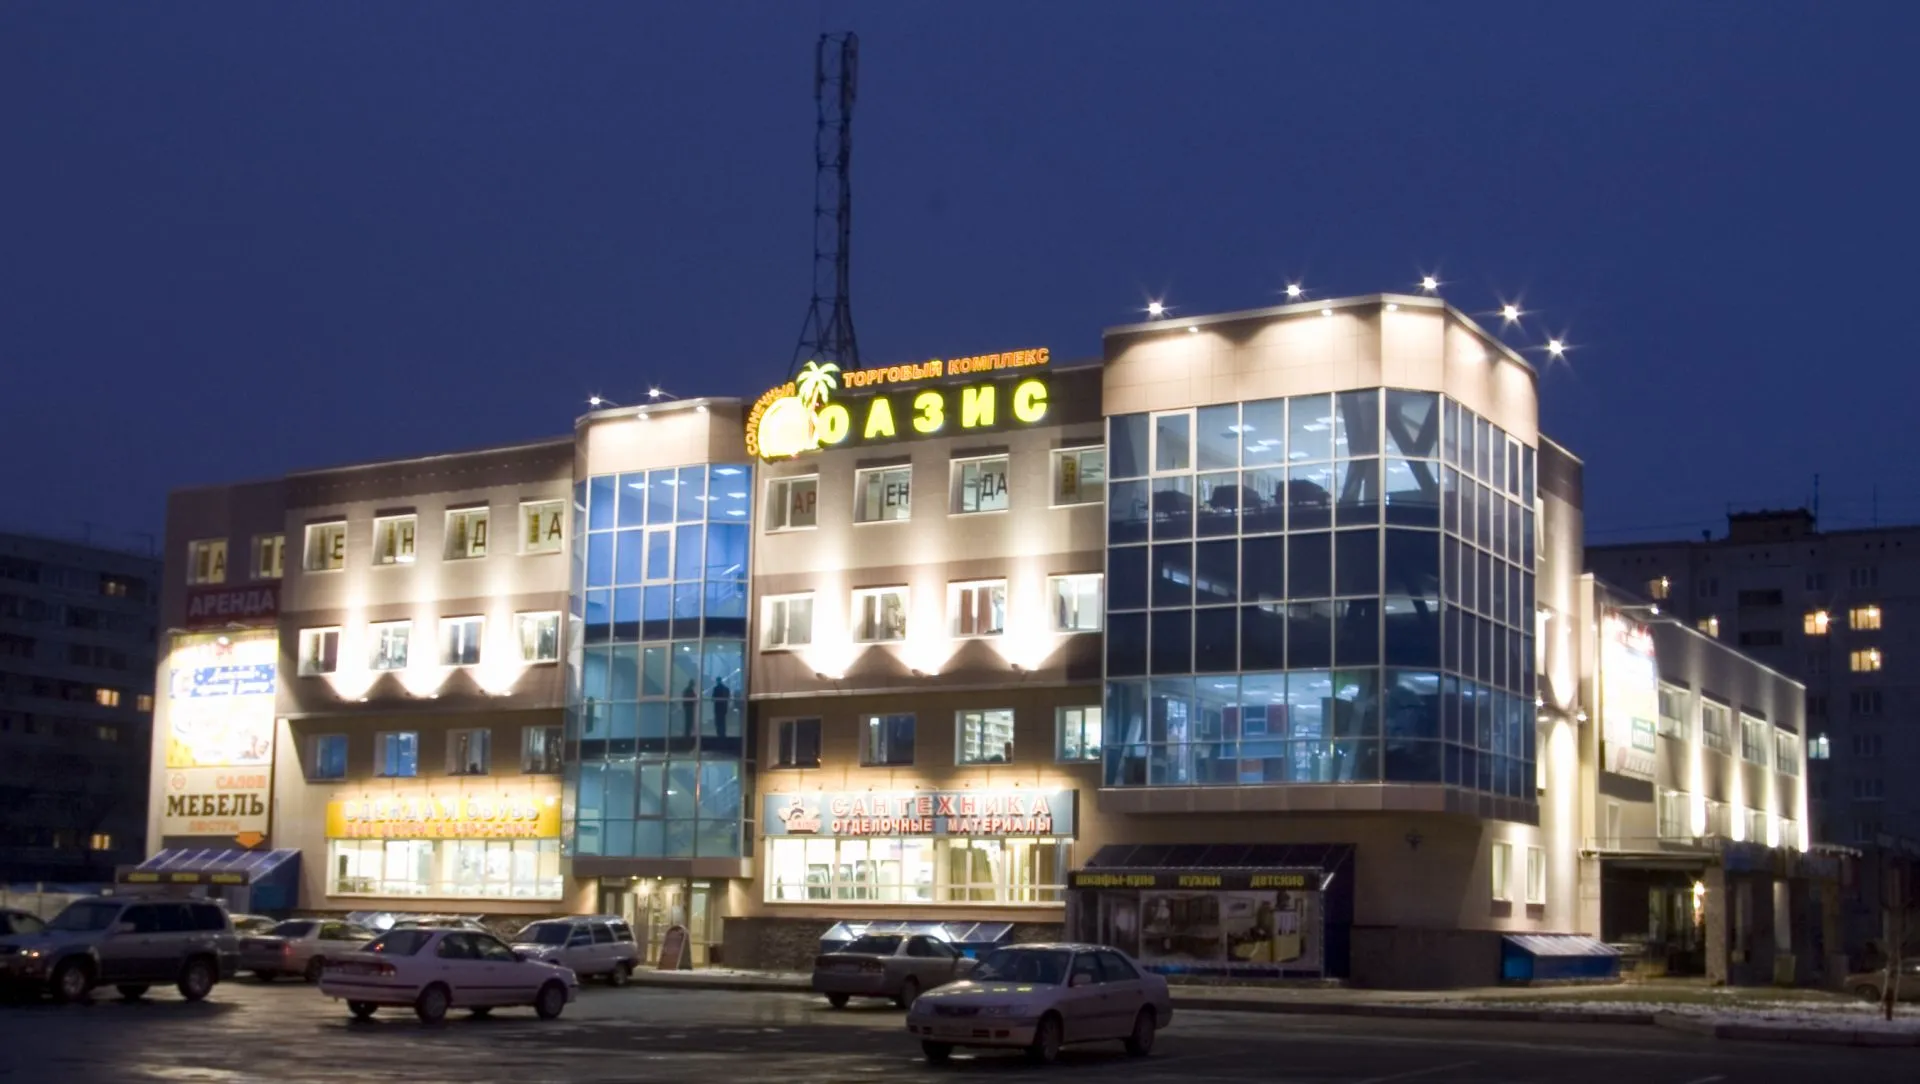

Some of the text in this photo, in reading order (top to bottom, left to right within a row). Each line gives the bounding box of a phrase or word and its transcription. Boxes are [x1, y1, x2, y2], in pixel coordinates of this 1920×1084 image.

[843, 347, 1050, 388] ТОРГОВЫЙ КОМПЛЕКС
[817, 378, 1049, 445] ОАЗИС
[188, 588, 276, 617] АРЕНДА
[166, 793, 265, 817] МЕБЕЛЬ
[829, 794, 1050, 817] САНТЕХНИКА
[831, 819, 933, 835] ОТДЕЛОЧНЫЕ
[947, 817, 1052, 834] МАТЕРИАЛЫ
